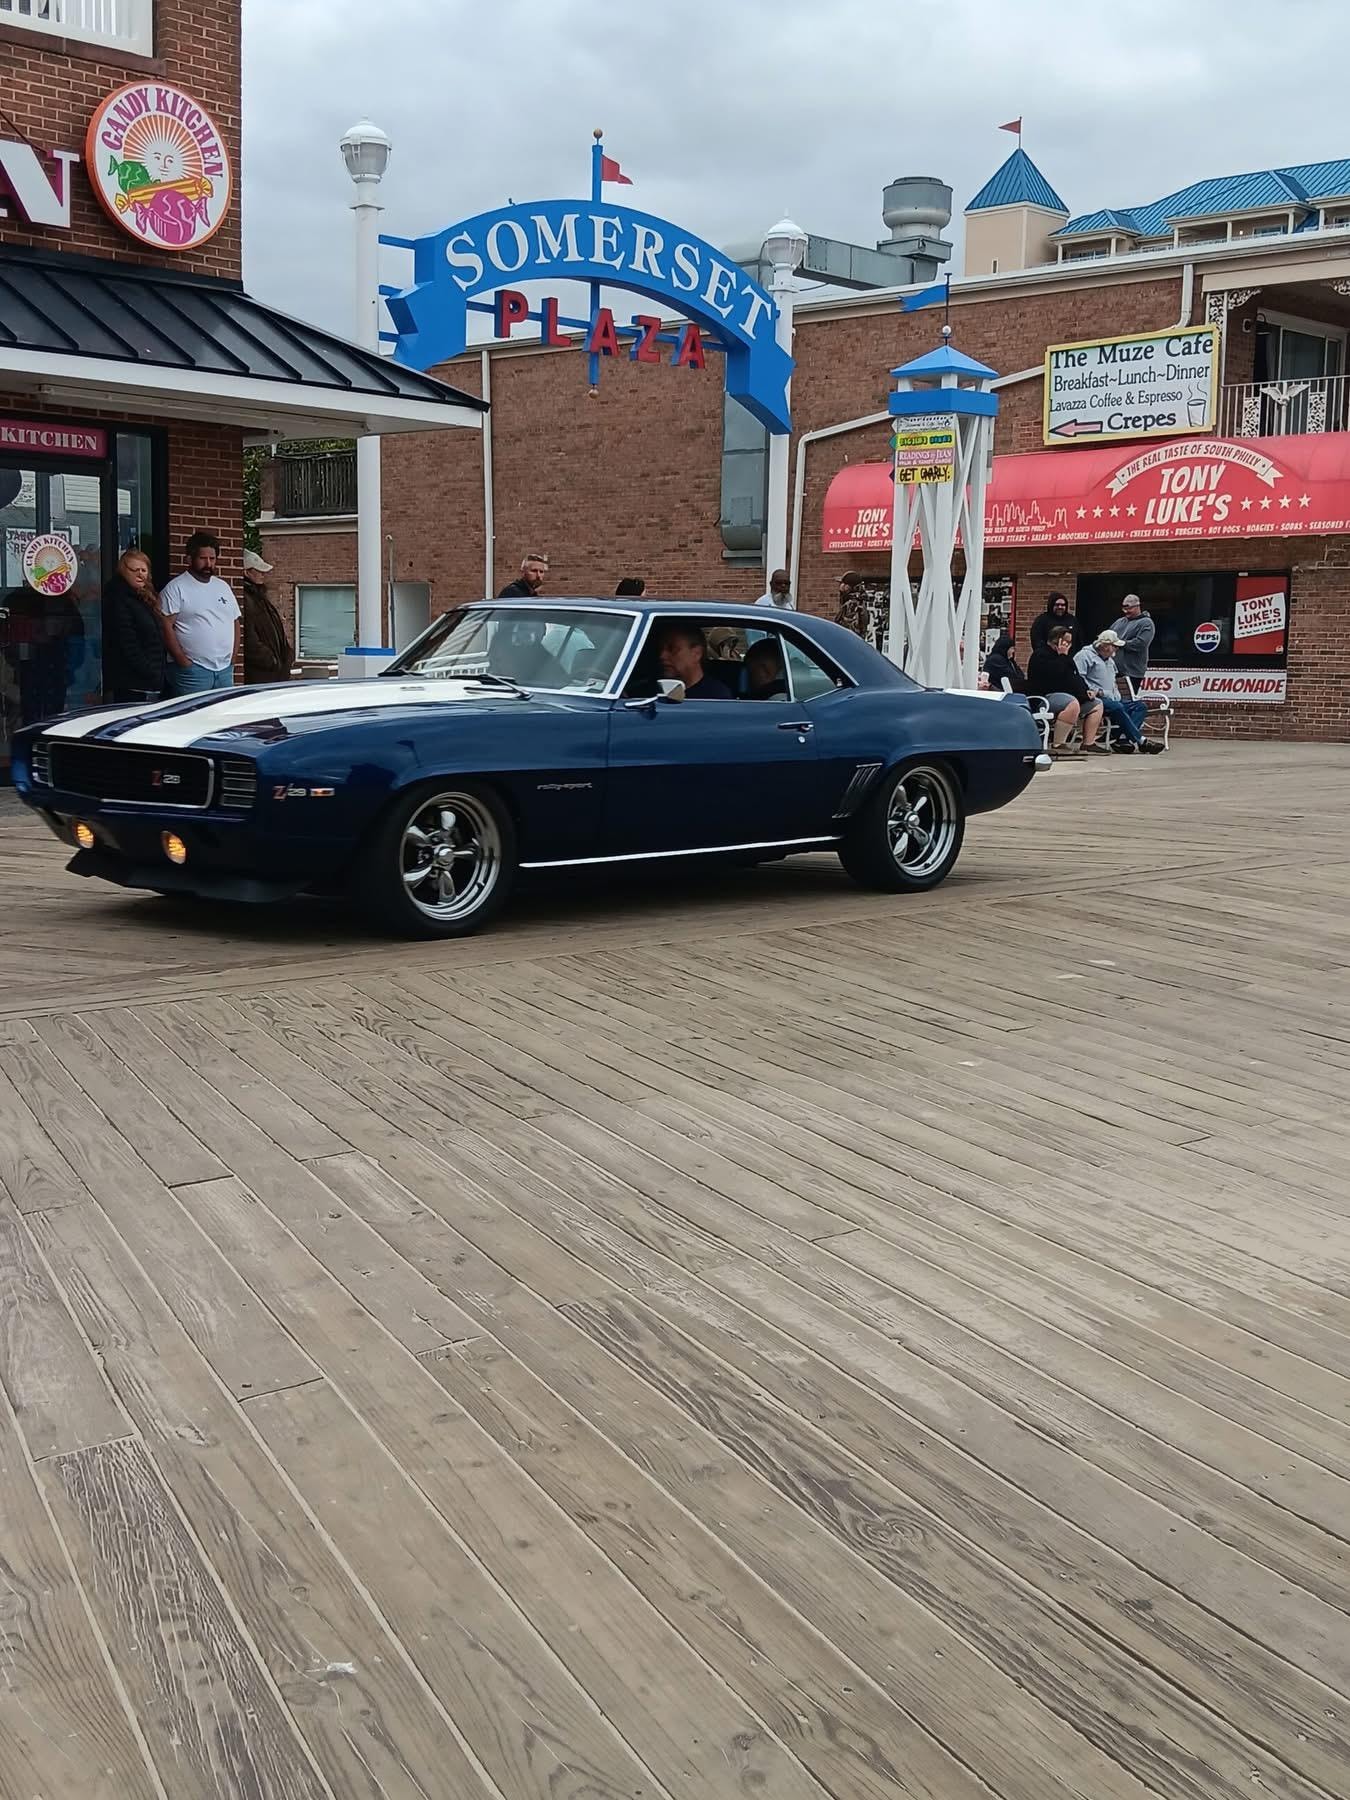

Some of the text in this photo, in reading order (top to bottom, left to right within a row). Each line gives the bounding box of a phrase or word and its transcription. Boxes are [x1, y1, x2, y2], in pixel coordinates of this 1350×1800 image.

[101, 87, 224, 178] CANDY KITCHEN
[445, 213, 773, 340] SOMERSET
[495, 290, 706, 369] PLAZA
[1051, 335, 1213, 368] The Muze Cafe
[1050, 389, 1183, 412] Lavazza Coffee & Espresso
[1107, 412, 1176, 431] Crepes
[0, 426, 97, 450] KITCHEN
[1126, 443, 1262, 476] THE REAL TASTE OF SOUTH PHILLY
[900, 467, 918, 481] GET
[1160, 461, 1226, 494] TONY
[857, 508, 887, 523] TONY
[1144, 492, 1232, 525] LUKE'S
[851, 523, 891, 538] LUKE'S
[984, 534, 1005, 543] CHICKEN
[1006, 534, 1027, 543] STEAKS
[1031, 533, 1053, 542] SALADS
[1057, 532, 1090, 541] SMOOTHIES
[1094, 530, 1125, 539] LEMONADE
[1130, 529, 1151, 538] CHEESE
[1152, 528, 1170, 537] FRIES
[1175, 527, 1202, 536] BURGERS
[1208, 526, 1222, 535] HOT
[1222, 525, 1241, 534] DOGS
[1247, 523, 1275, 532] HOAGIES
[1280, 522, 1303, 531] SODAS
[1309, 520, 1344, 530] SEASONED
[829, 540, 863, 549] CHEESESTEAKS
[1241, 597, 1274, 612] TONY
[1238, 608, 1281, 625] LUKE'S
[1140, 676, 1285, 693] AKES FRESH LEMONADE
